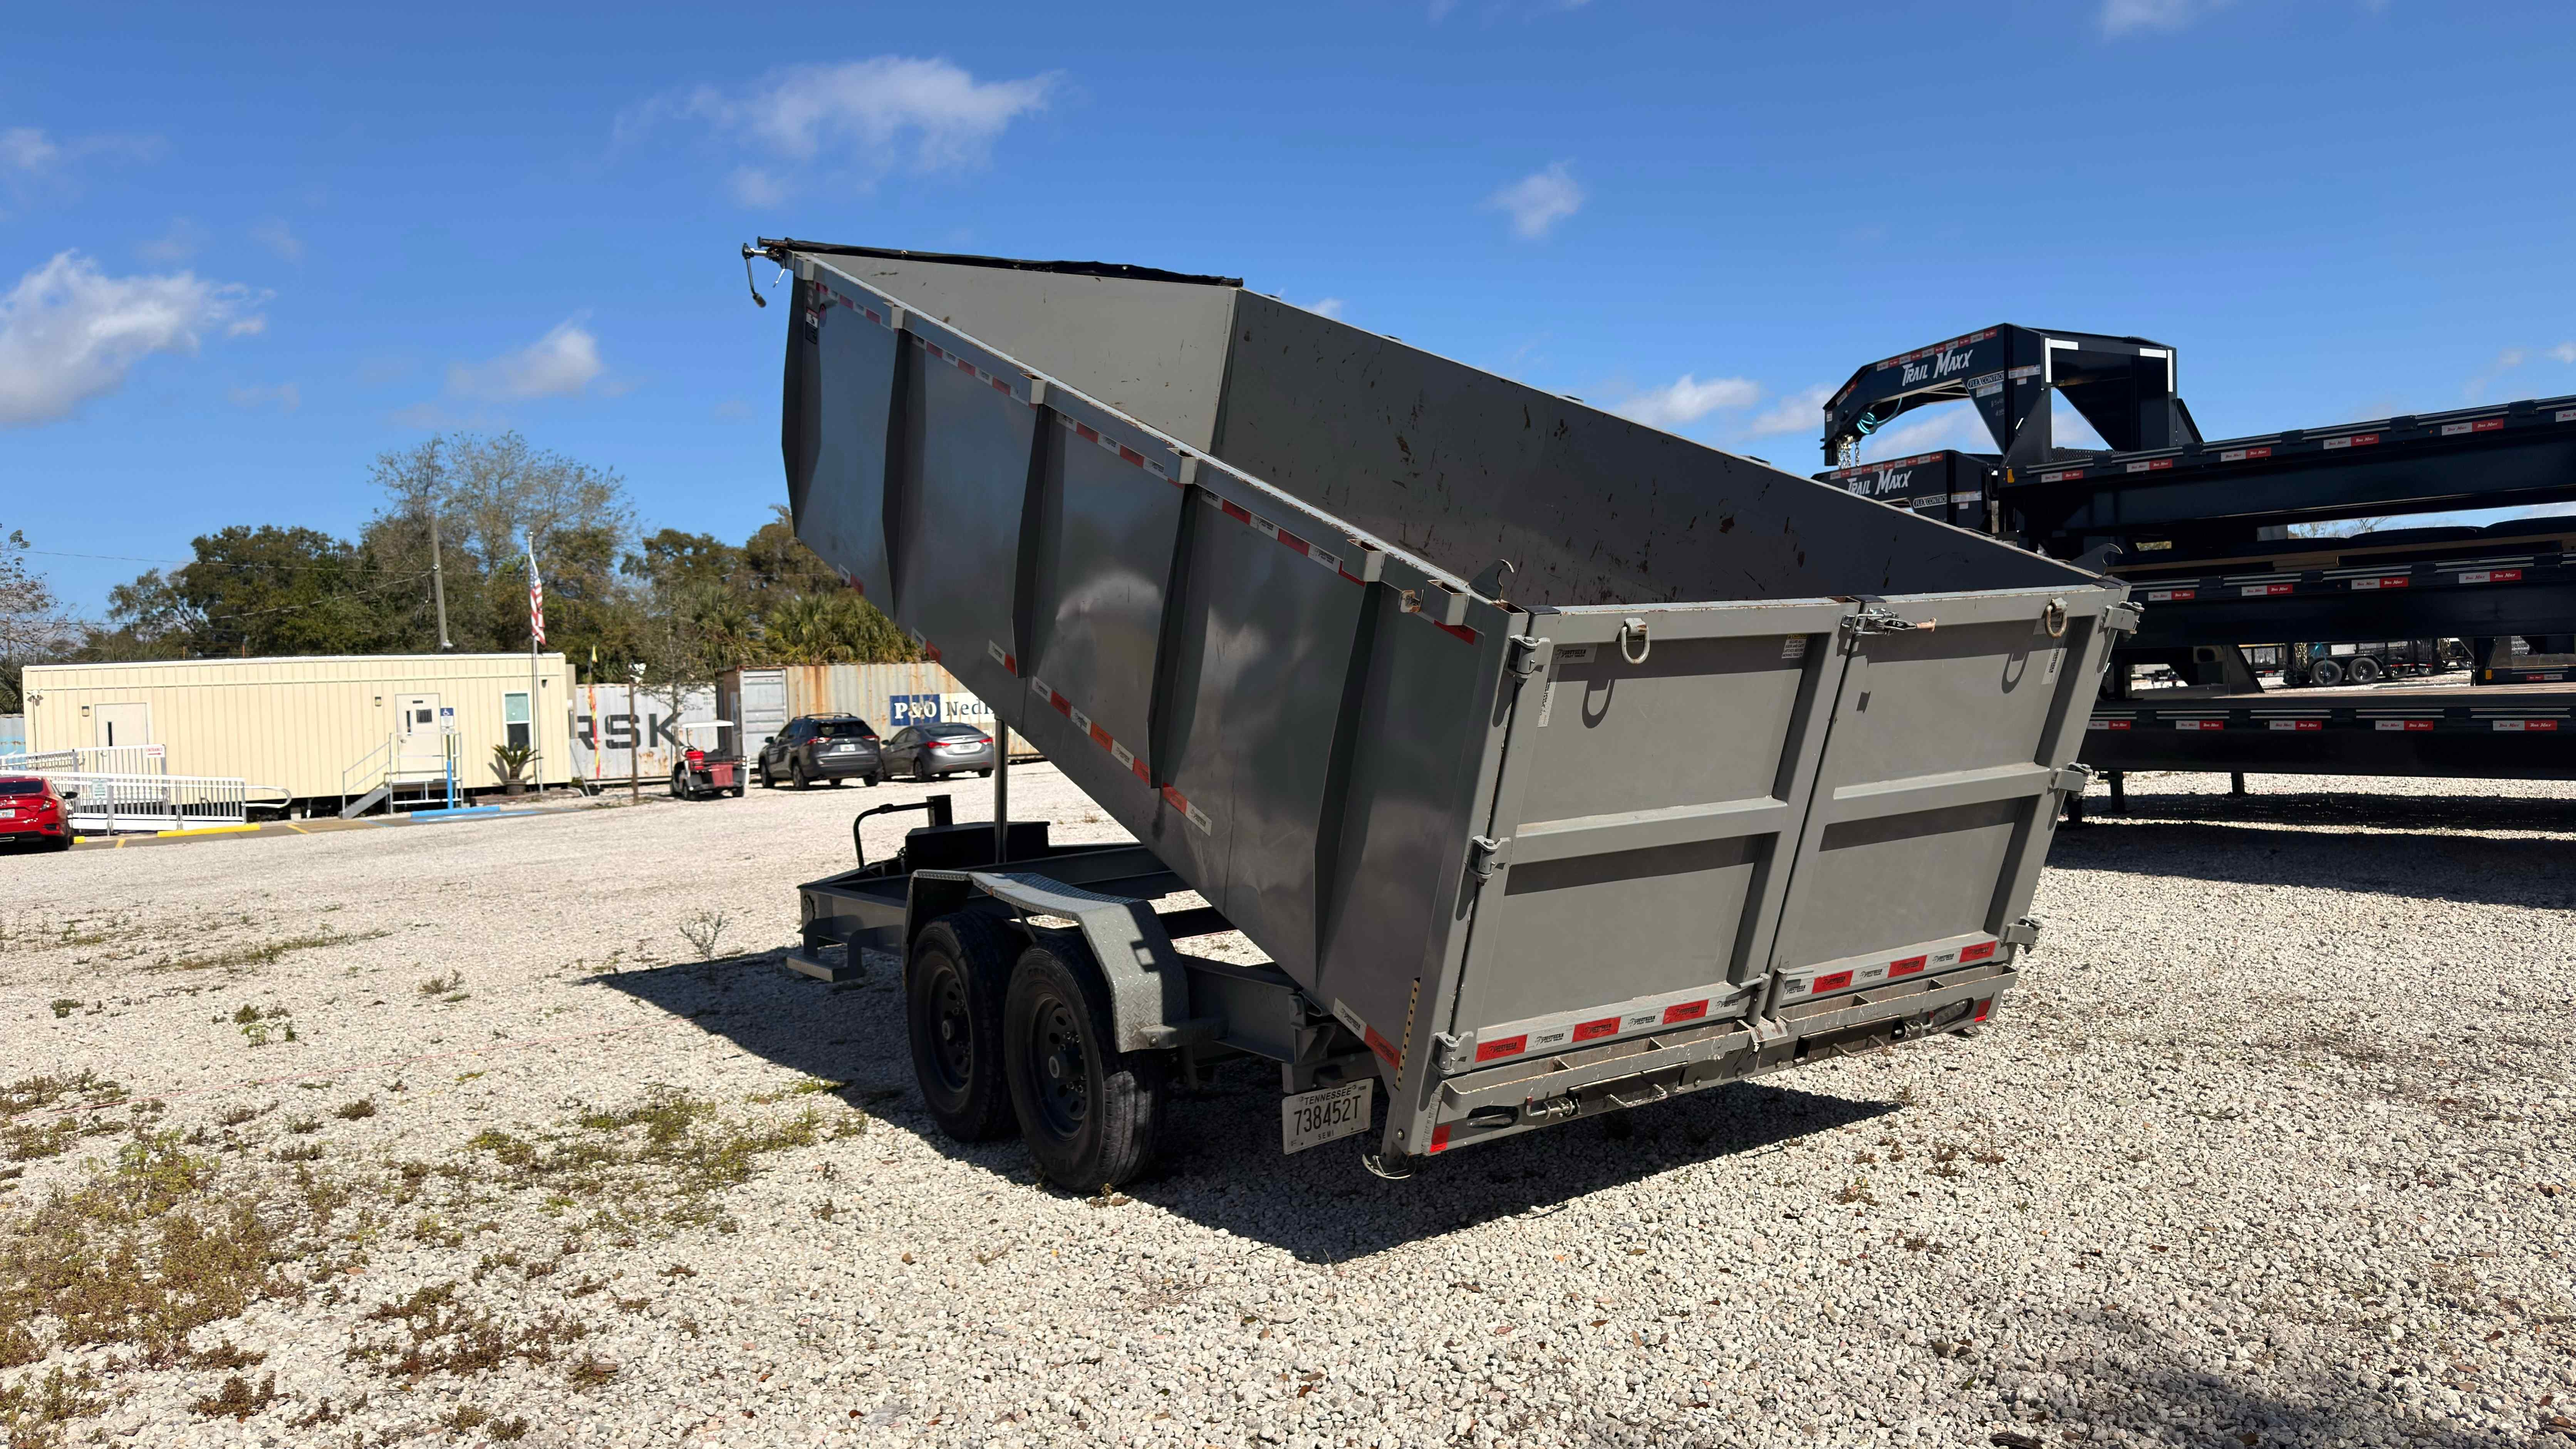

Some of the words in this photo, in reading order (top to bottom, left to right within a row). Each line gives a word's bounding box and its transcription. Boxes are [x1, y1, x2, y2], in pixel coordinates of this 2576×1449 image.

[894, 701, 937, 719] P&O
[1305, 1087, 1352, 1106] TENNESSEE
[1294, 1095, 1361, 1136] 738452T
[1318, 1130, 1334, 1140] SEMI
